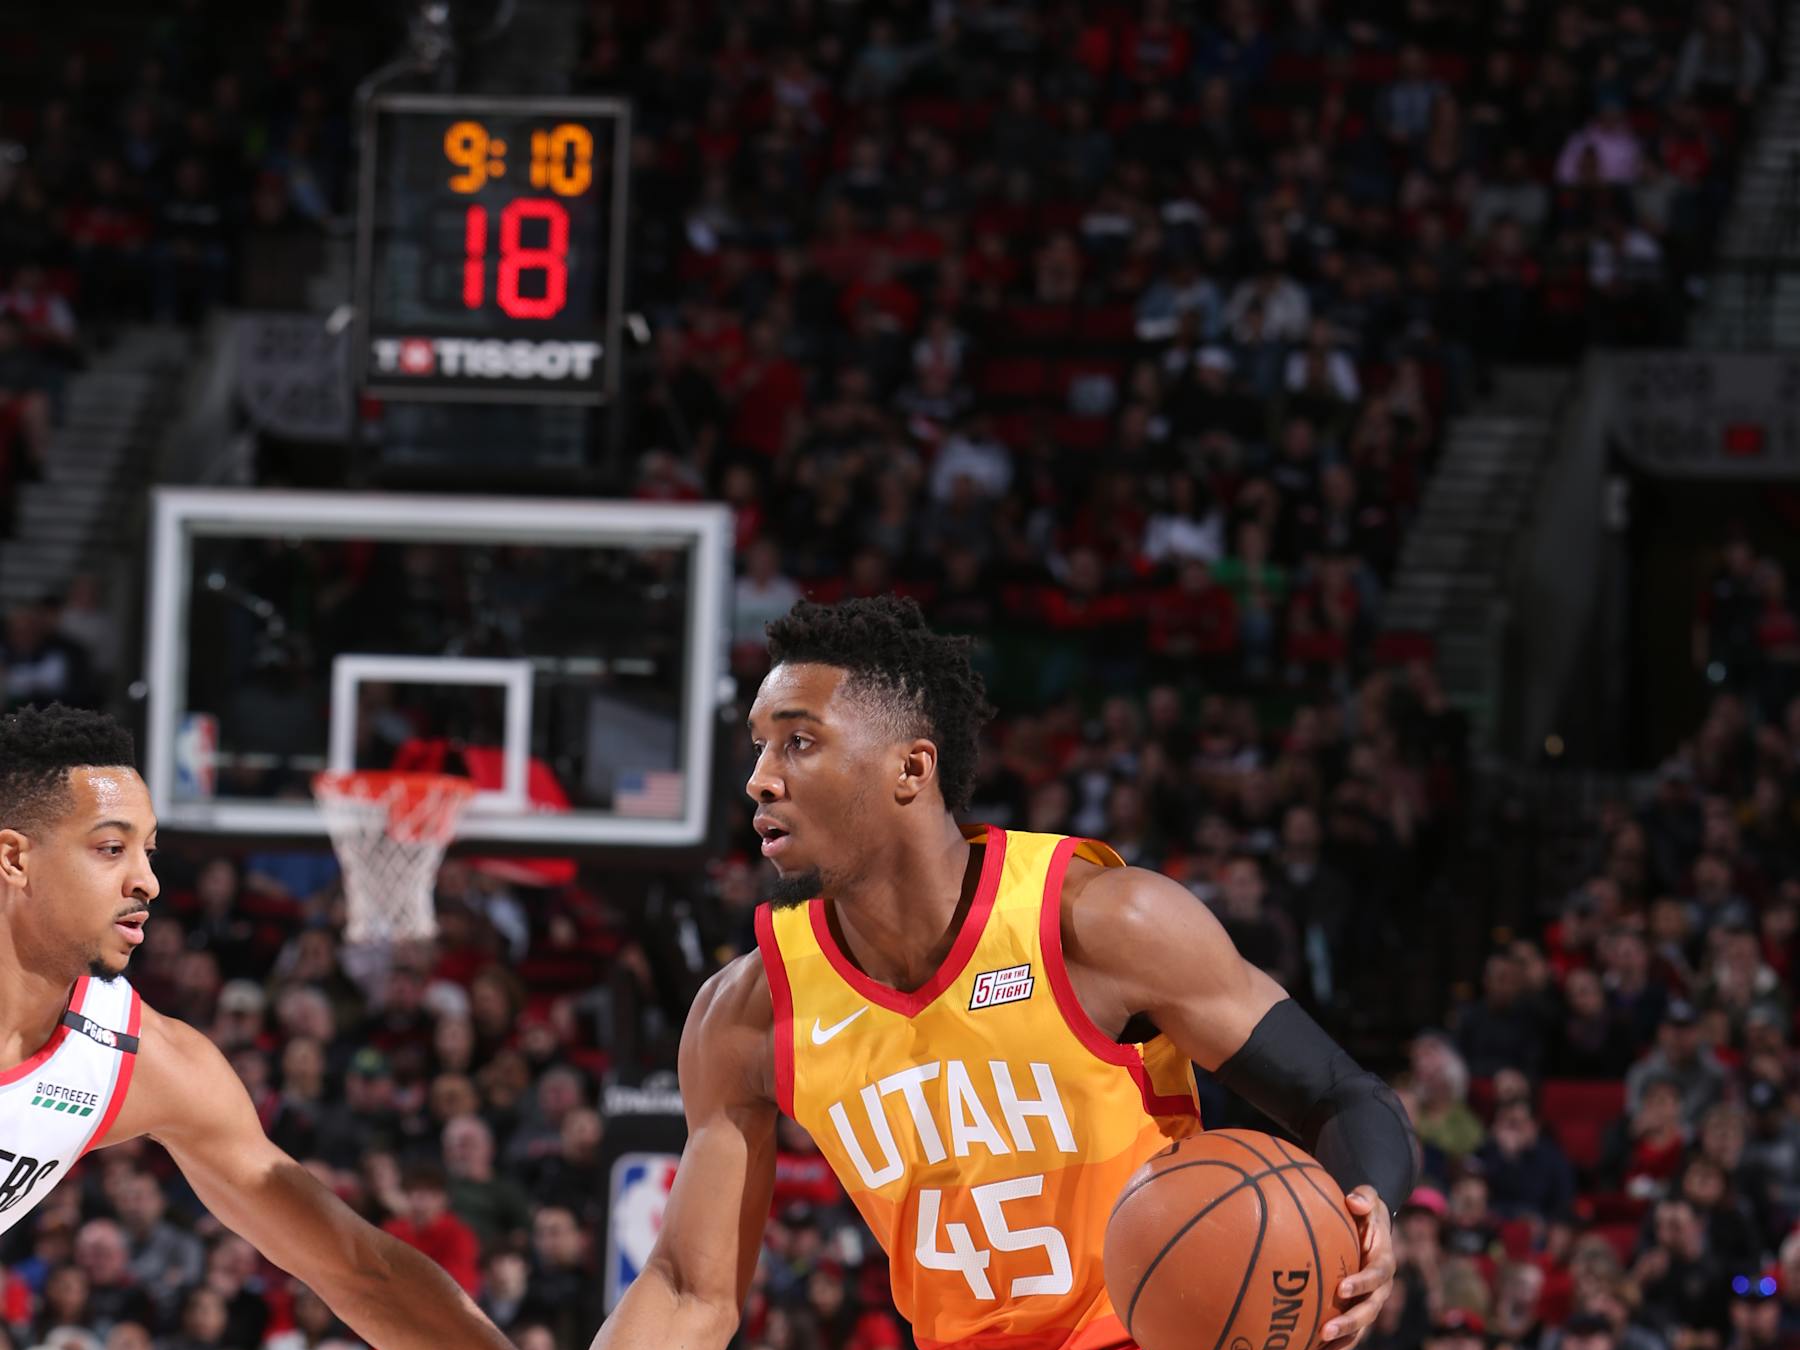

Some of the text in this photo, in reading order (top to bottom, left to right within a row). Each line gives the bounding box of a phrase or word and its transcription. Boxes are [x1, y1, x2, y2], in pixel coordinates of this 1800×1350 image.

[463, 197, 570, 320] 18
[437, 338, 601, 379] TISSOT
[976, 976, 1029, 1004] 5 FIGHT
[1000, 969, 1026, 982] FOR THE
[828, 1060, 1078, 1189] UTAH
[915, 1174, 1073, 1301] 45
